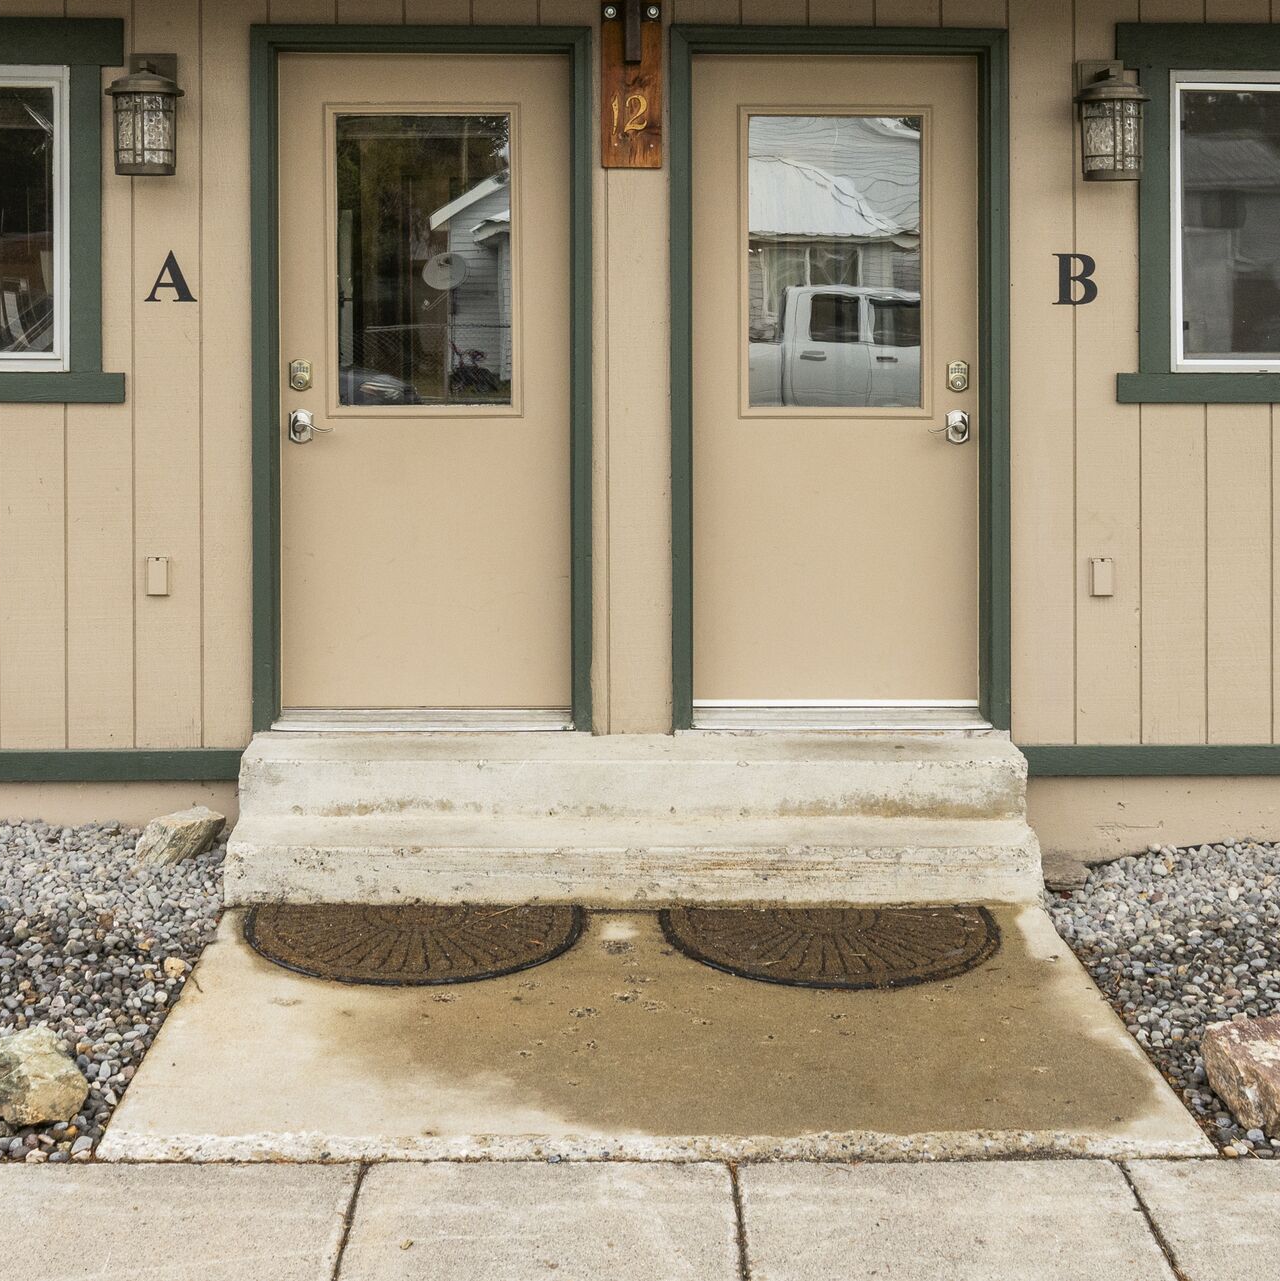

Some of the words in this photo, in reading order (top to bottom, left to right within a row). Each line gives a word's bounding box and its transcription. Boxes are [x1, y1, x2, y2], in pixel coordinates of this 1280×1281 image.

[611, 94, 648, 135] 12
[144, 249, 198, 302] A
[1051, 253, 1098, 306] B
